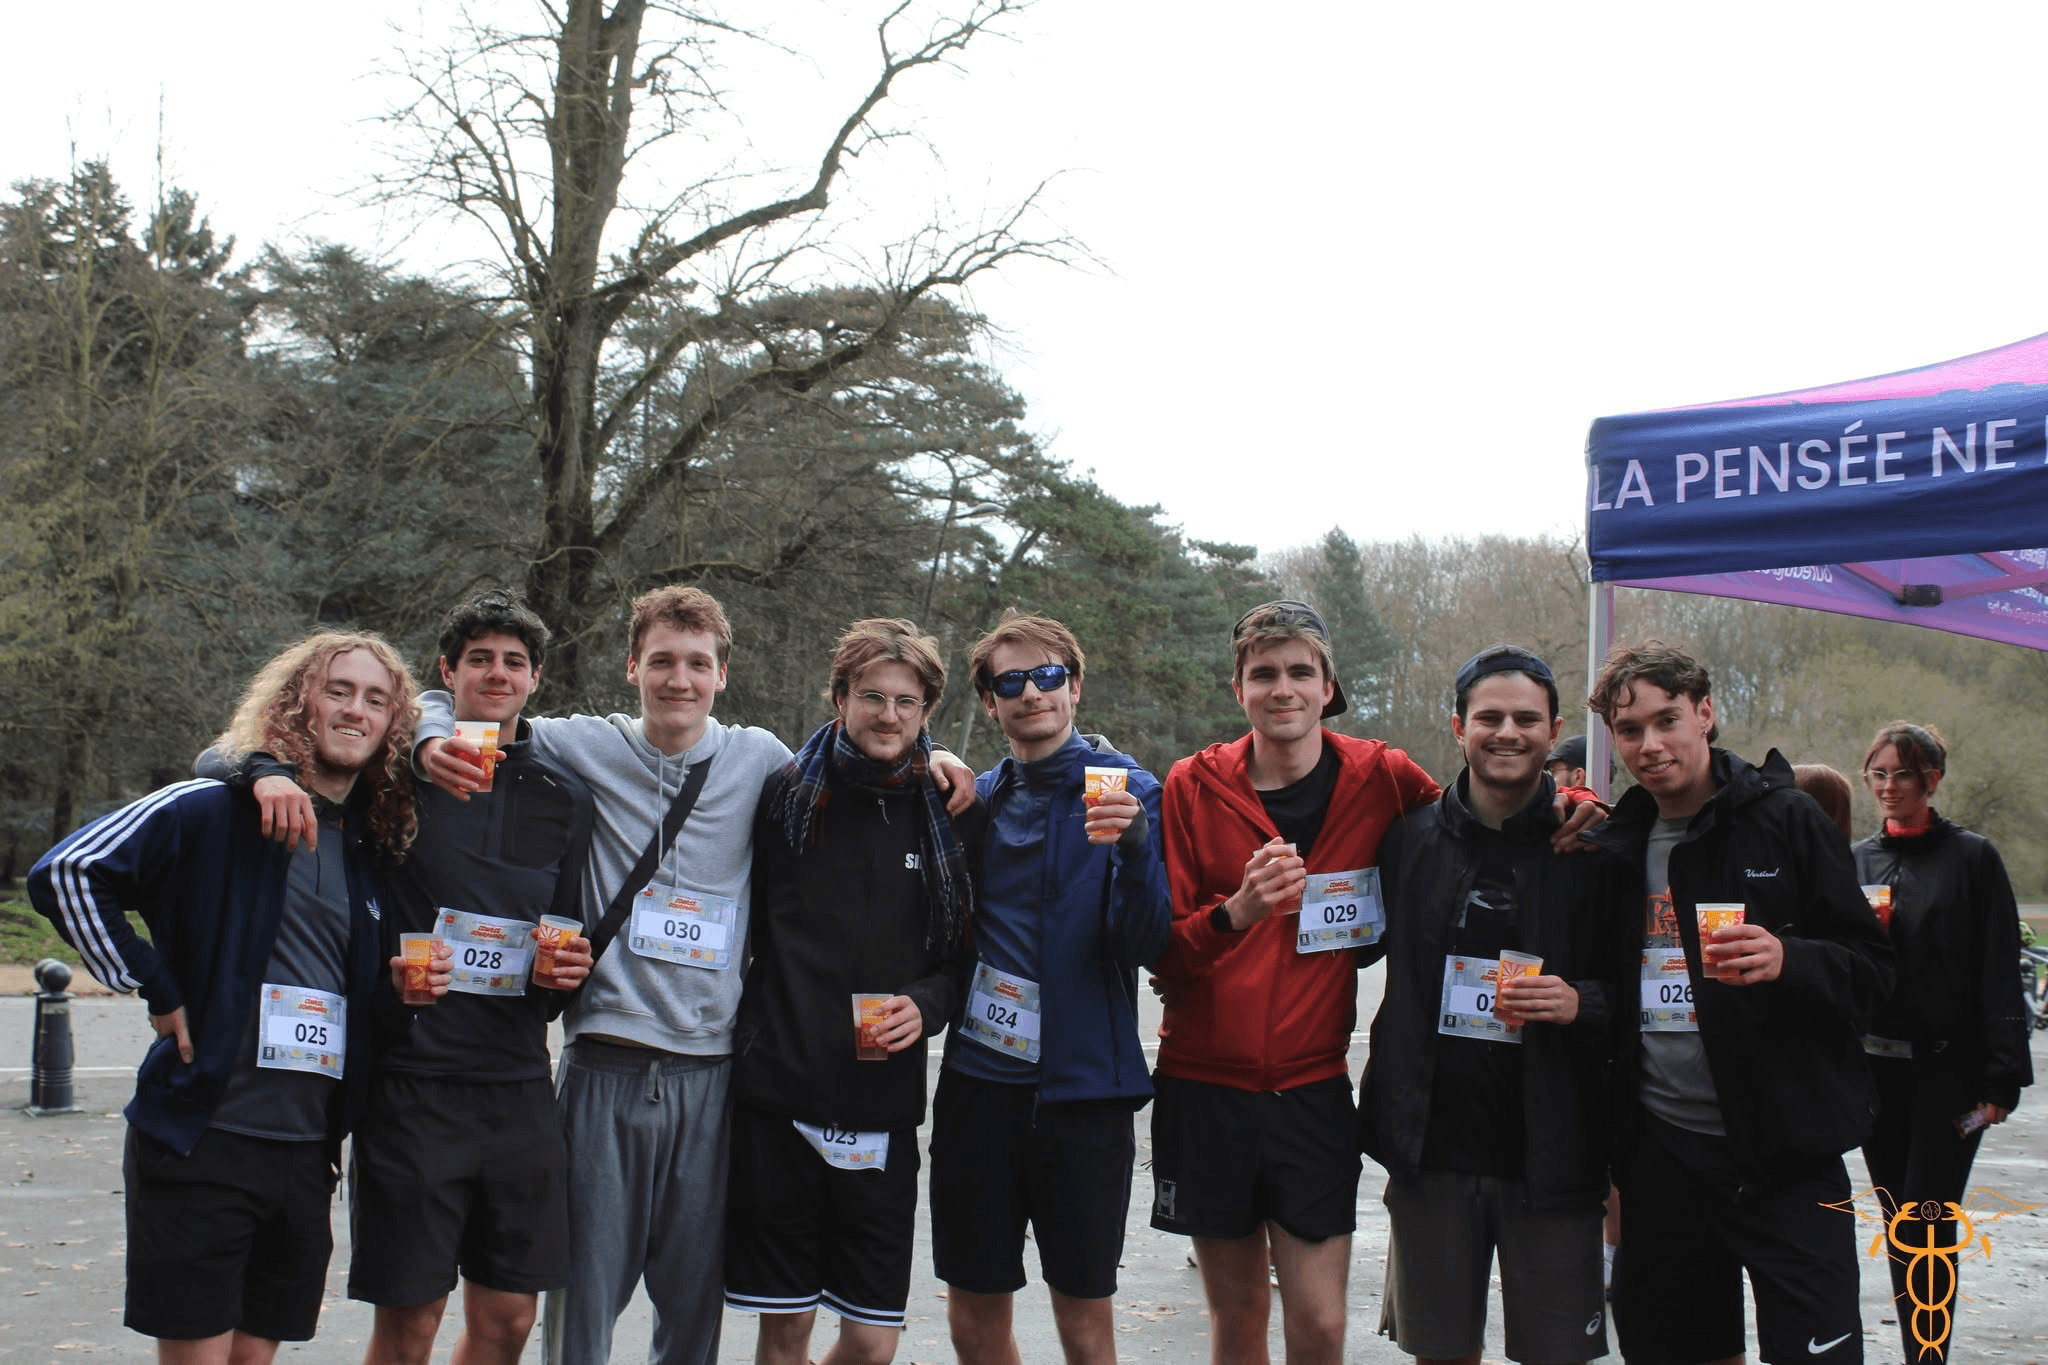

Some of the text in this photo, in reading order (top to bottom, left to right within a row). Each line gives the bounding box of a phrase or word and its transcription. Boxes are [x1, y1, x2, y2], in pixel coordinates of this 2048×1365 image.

[1591, 459, 1654, 512] LA
[1675, 419, 1906, 503] PENSÉE
[1931, 418, 2017, 477] NE
[1324, 904, 1357, 924] 029
[664, 919, 701, 941] 030
[463, 947, 503, 969] 028
[1476, 993, 1495, 1012] 02
[1660, 984, 1694, 1004] 026
[987, 1003, 1018, 1029] 024
[295, 1023, 327, 1046] 025
[823, 1127, 857, 1145] 023
